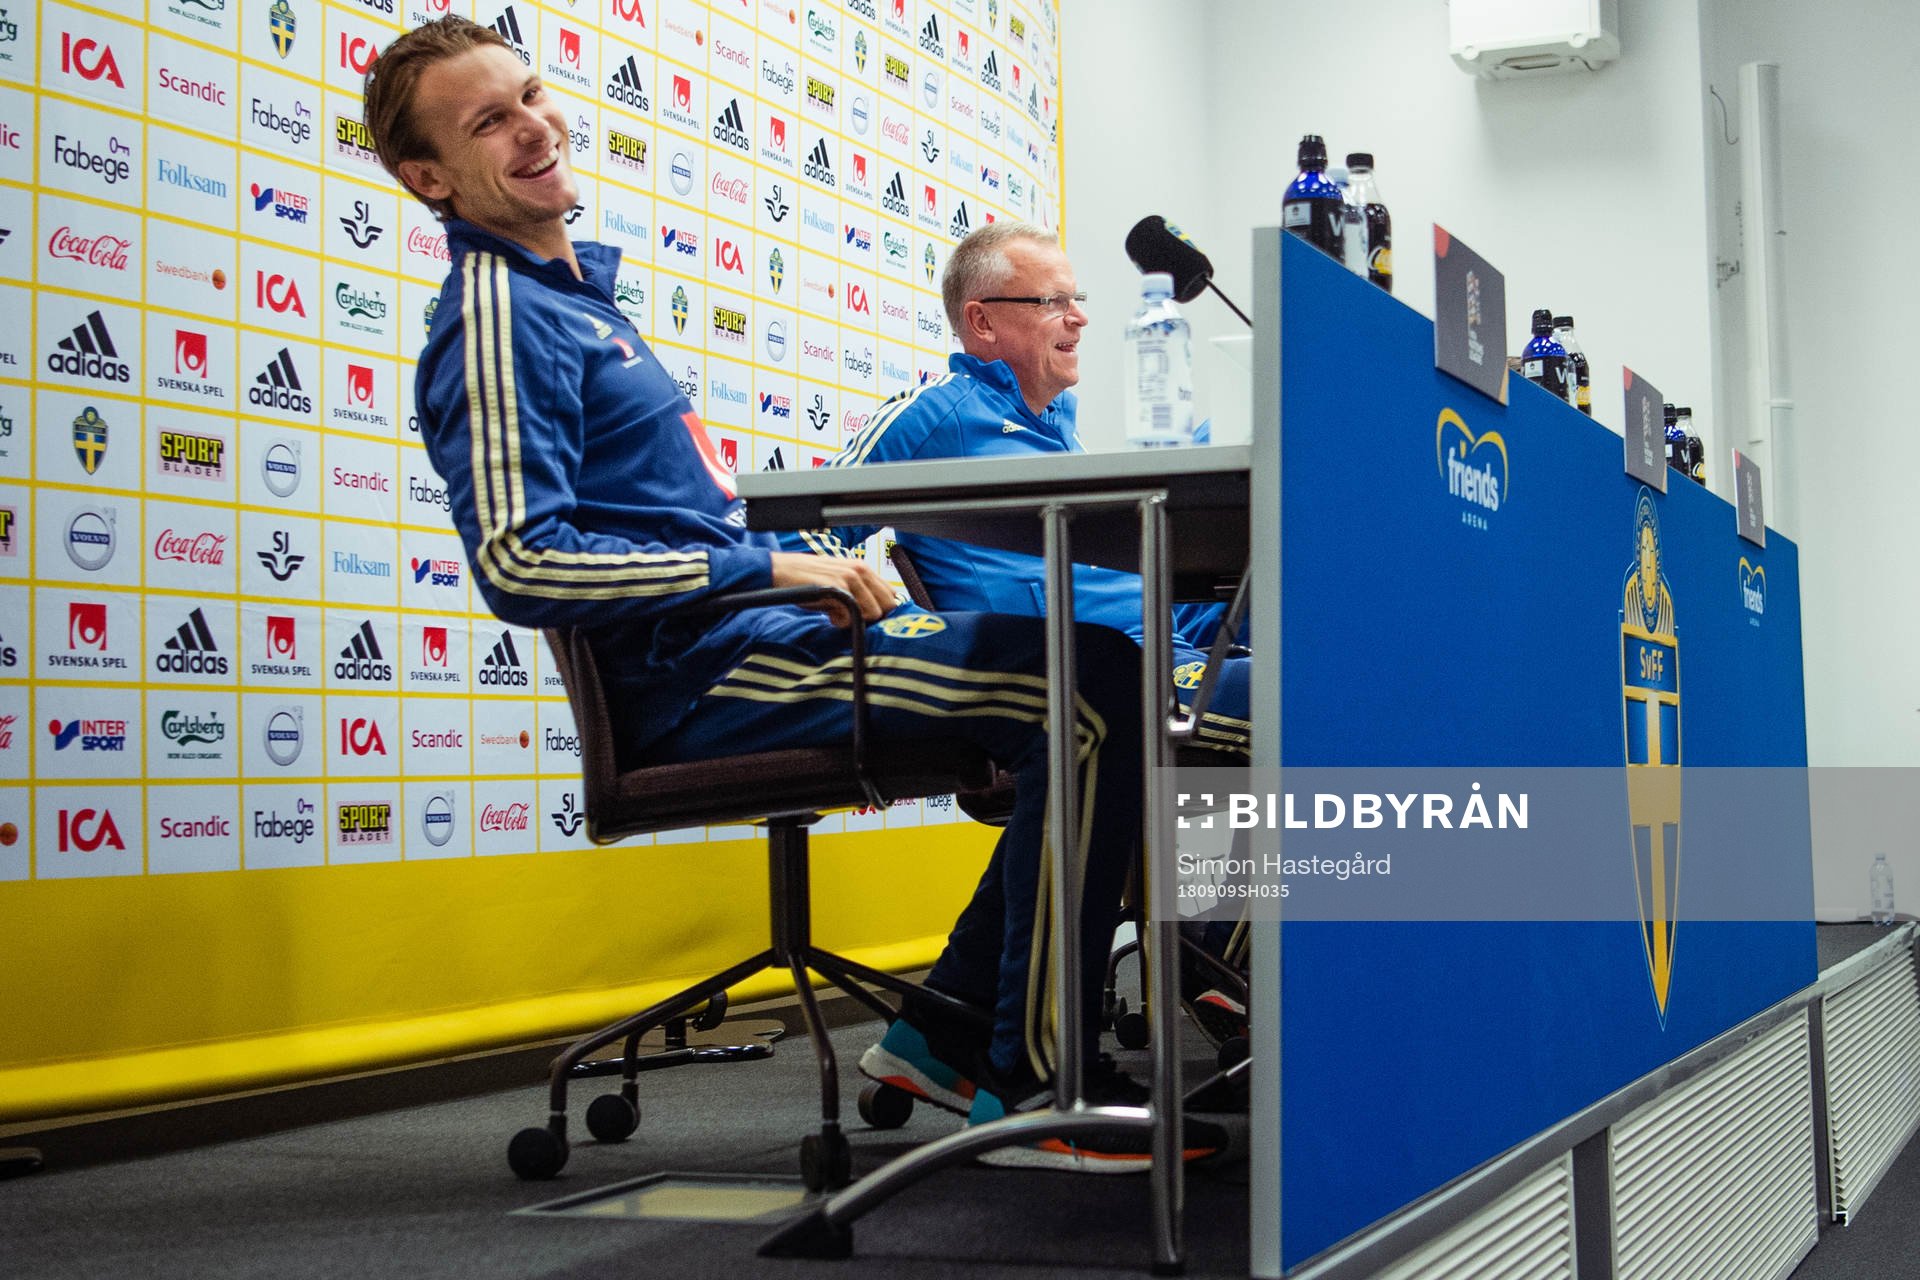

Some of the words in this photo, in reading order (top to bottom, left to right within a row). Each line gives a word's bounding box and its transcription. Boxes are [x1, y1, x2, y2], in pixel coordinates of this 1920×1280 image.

[61, 31, 125, 89] ICA
[716, 40, 750, 68] Scandic
[159, 68, 226, 106] Scandic
[548, 65, 575, 80] SVENSKA
[577, 76, 591, 87] SPEL
[762, 60, 794, 94] Fabege
[607, 83, 649, 112] adidas
[807, 76, 835, 107] SPORT
[252, 98, 311, 144] Fabege
[663, 108, 686, 125] SVENSKA
[687, 117, 700, 130] SPEL
[336, 116, 376, 151] SPO
[569, 130, 589, 152] ege
[714, 124, 750, 151] adidas
[927, 130, 935, 147] SJ
[339, 145, 378, 163] BLADE
[609, 130, 646, 164] SPORT
[762, 148, 782, 163] SVENSKA
[55, 135, 129, 184] Fabege
[610, 154, 644, 171] BLADET
[156, 158, 227, 199] Folksam
[804, 163, 835, 187] adidas
[275, 189, 308, 210] INTER
[712, 172, 749, 204] Coca-Cola
[773, 184, 782, 203] SJ
[275, 205, 308, 224] SPORT
[354, 201, 369, 224] SJ
[882, 196, 910, 218] adidas
[605, 209, 647, 240] Folksam
[48, 226, 133, 271] Coca-Cola
[676, 231, 697, 246] INTER
[676, 242, 696, 256] SPORT
[716, 238, 744, 275] ICA
[156, 260, 209, 283] Swedbank
[257, 270, 307, 318] ICA
[336, 282, 386, 319] Carlsberg
[617, 280, 644, 304] rlsberg
[847, 282, 870, 316] ICA
[713, 306, 746, 336] SPORT
[882, 300, 909, 321] Scandic
[715, 329, 745, 343] BLADET
[804, 340, 834, 362] Scandic
[48, 352, 130, 382] adidas
[844, 349, 873, 379] Fabege
[158, 377, 201, 394] SVENSKA
[204, 385, 225, 398] SPEL
[249, 386, 312, 413] adidas
[711, 380, 747, 405] Folksam
[772, 407, 790, 419] SPORT
[773, 395, 790, 408] INTER
[815, 394, 823, 411] SJ
[334, 409, 368, 422] SVENSKA
[370, 415, 388, 426] SPEL
[160, 431, 224, 467] SPORT
[164, 462, 222, 478] BLADET
[334, 467, 389, 492] Scandic
[1447, 440, 1499, 512] friends
[410, 476, 452, 513] Fabeg
[72, 532, 109, 544] VOLVO
[154, 528, 228, 565] Coca-Cola
[273, 531, 289, 555] SJ
[333, 551, 391, 577] Folksam
[432, 560, 460, 574] INTER
[432, 573, 459, 587] SPORT
[49, 655, 99, 667] SVENSKA
[102, 658, 127, 668] SPEL
[156, 650, 228, 675] adidas
[252, 664, 290, 675] SVENSKA
[293, 665, 312, 676] SPEL
[334, 659, 392, 681] adidas
[410, 672, 443, 681] SVENSKA
[444, 672, 460, 682] SPEL
[479, 665, 528, 686] adidas
[82, 720, 125, 735] INTER
[161, 710, 225, 746] Carlsberg
[341, 718, 387, 756] ICA
[412, 729, 463, 748] Scandic
[480, 734, 518, 745] Swedbank
[82, 736, 125, 751] SPORT
[546, 728, 582, 757] Fabeg
[562, 793, 575, 813] SJ
[160, 816, 230, 838] Scandic
[255, 811, 314, 844] Fabege
[339, 804, 391, 833] SPORT
[480, 803, 529, 832] Coca-Cola
[58, 808, 126, 852] ICA
[342, 832, 390, 842] BLADET
